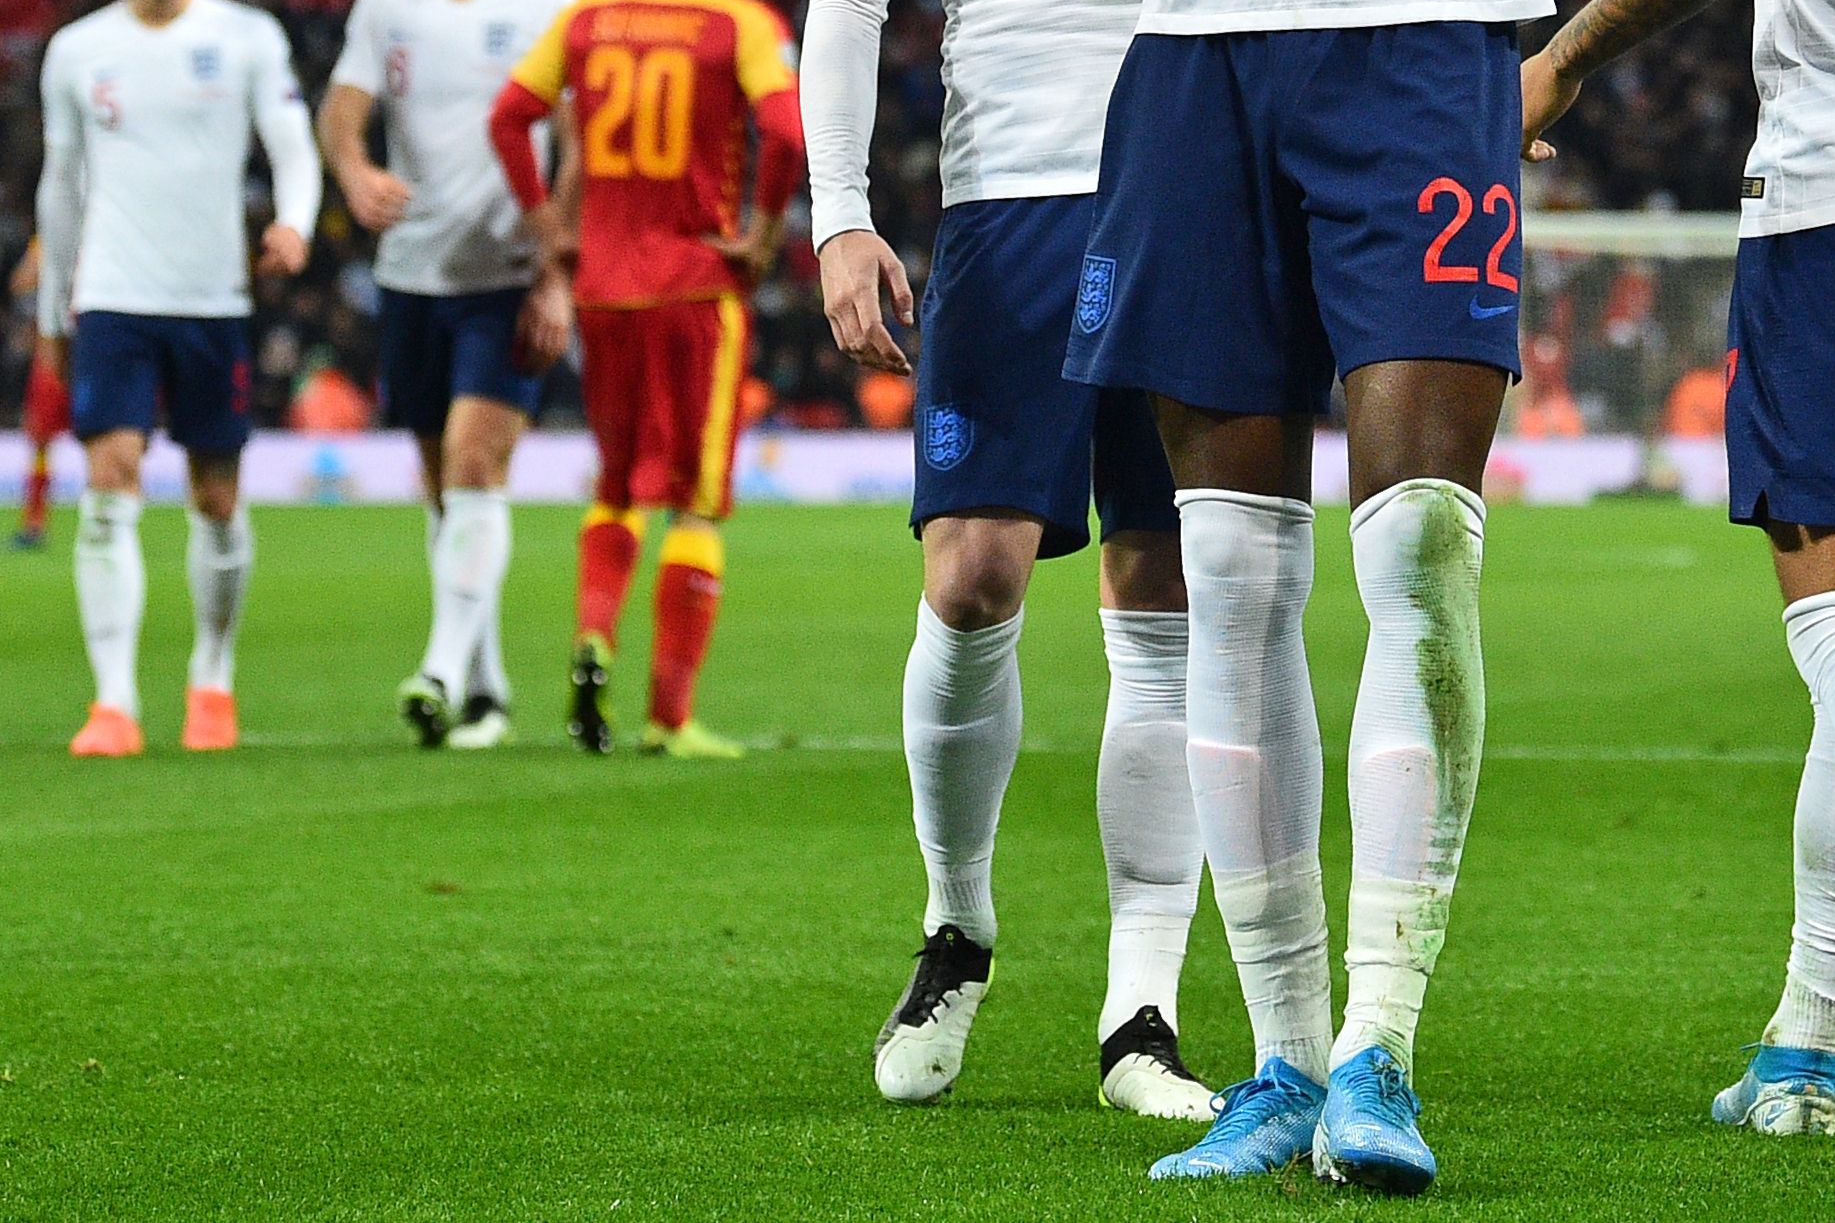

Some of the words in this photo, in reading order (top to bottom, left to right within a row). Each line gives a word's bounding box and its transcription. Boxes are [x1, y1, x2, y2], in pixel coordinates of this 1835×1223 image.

[91, 78, 123, 129] 5
[584, 42, 697, 180] 20
[1416, 177, 1519, 293] 22
